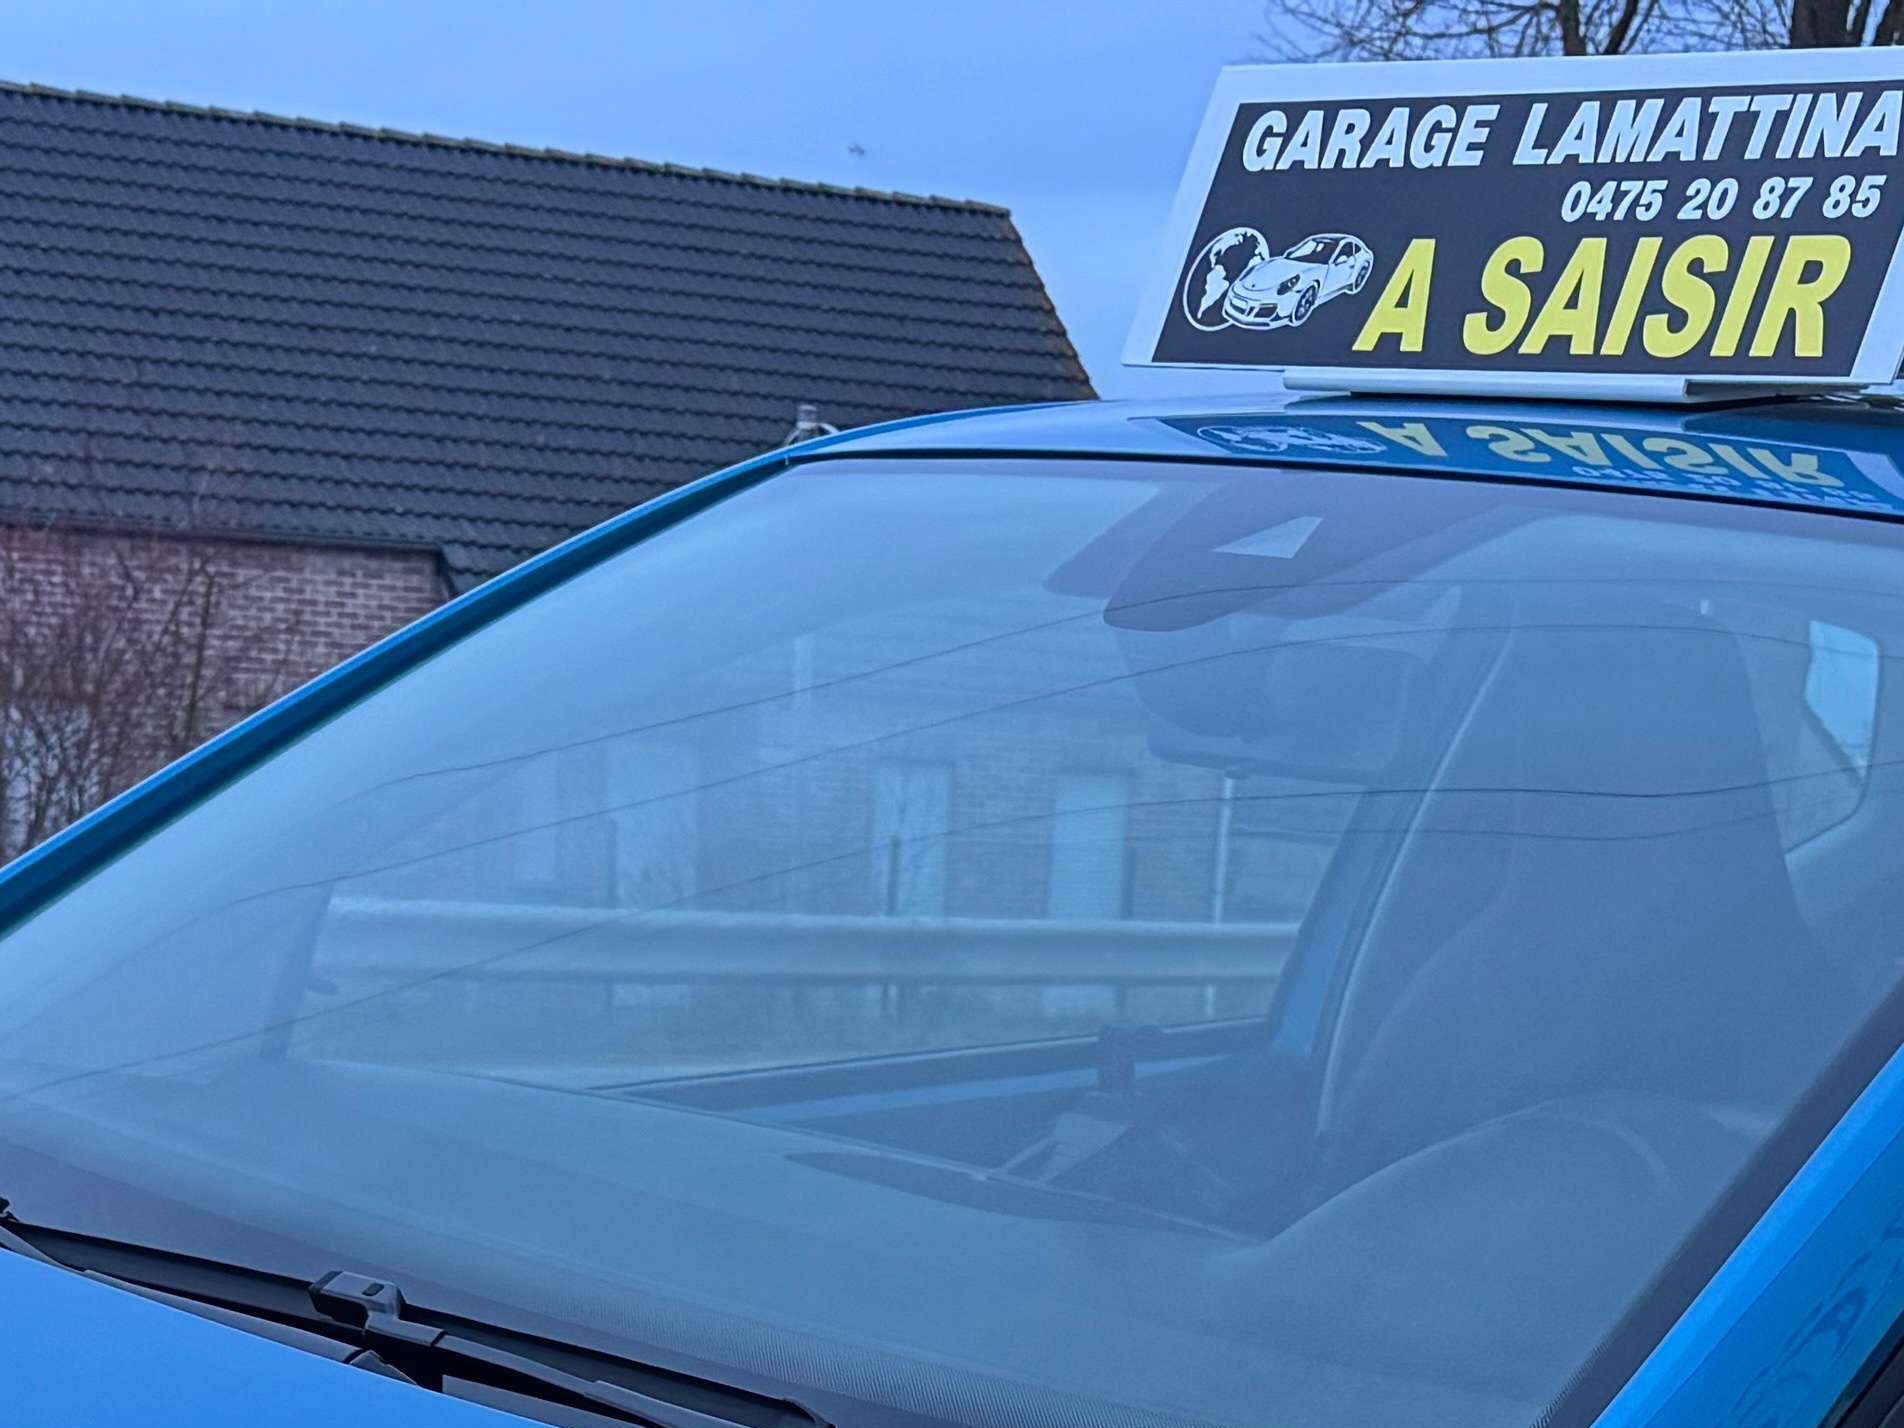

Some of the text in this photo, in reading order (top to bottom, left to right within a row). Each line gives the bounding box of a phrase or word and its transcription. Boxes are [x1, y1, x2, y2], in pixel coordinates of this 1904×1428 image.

[1242, 90, 1904, 172] GARAGE LAMATTINA
[1560, 174, 1887, 223] 0475 20 87 85
[1351, 234, 1852, 358] A SAISIR
